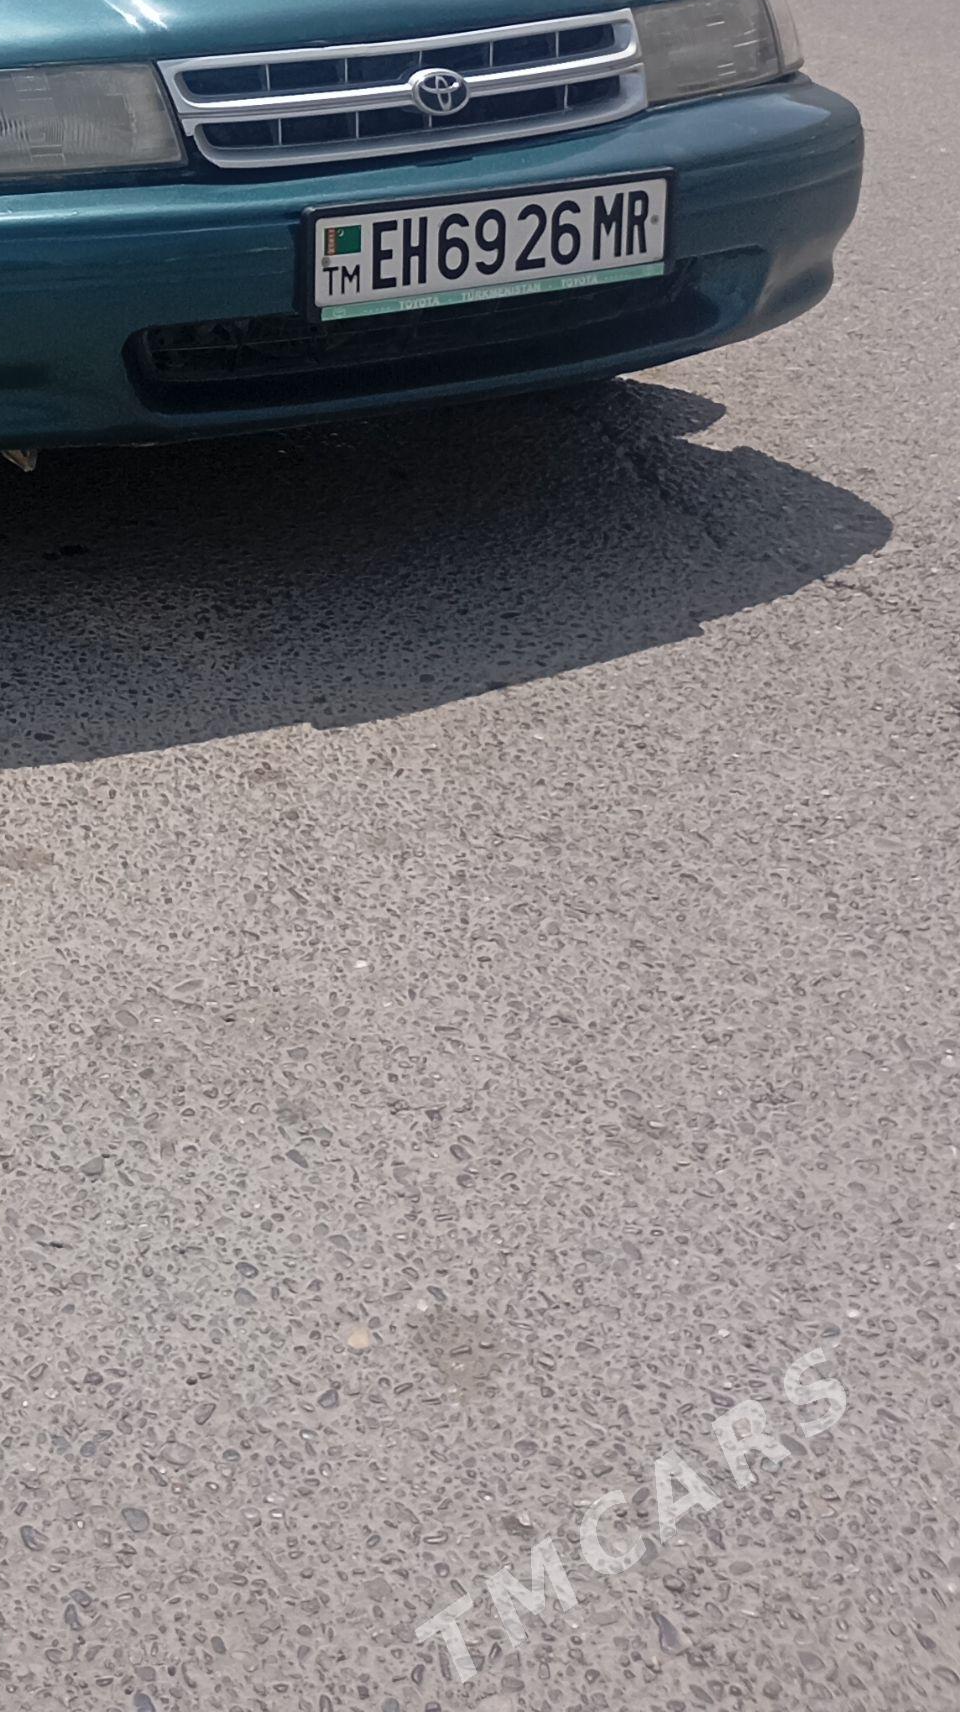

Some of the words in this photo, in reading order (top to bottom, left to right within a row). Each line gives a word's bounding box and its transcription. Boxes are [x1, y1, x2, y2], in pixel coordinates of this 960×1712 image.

[322, 263, 361, 296] TM
[399, 296, 440, 311] TOYOTA
[560, 274, 598, 288] TOYOTA
